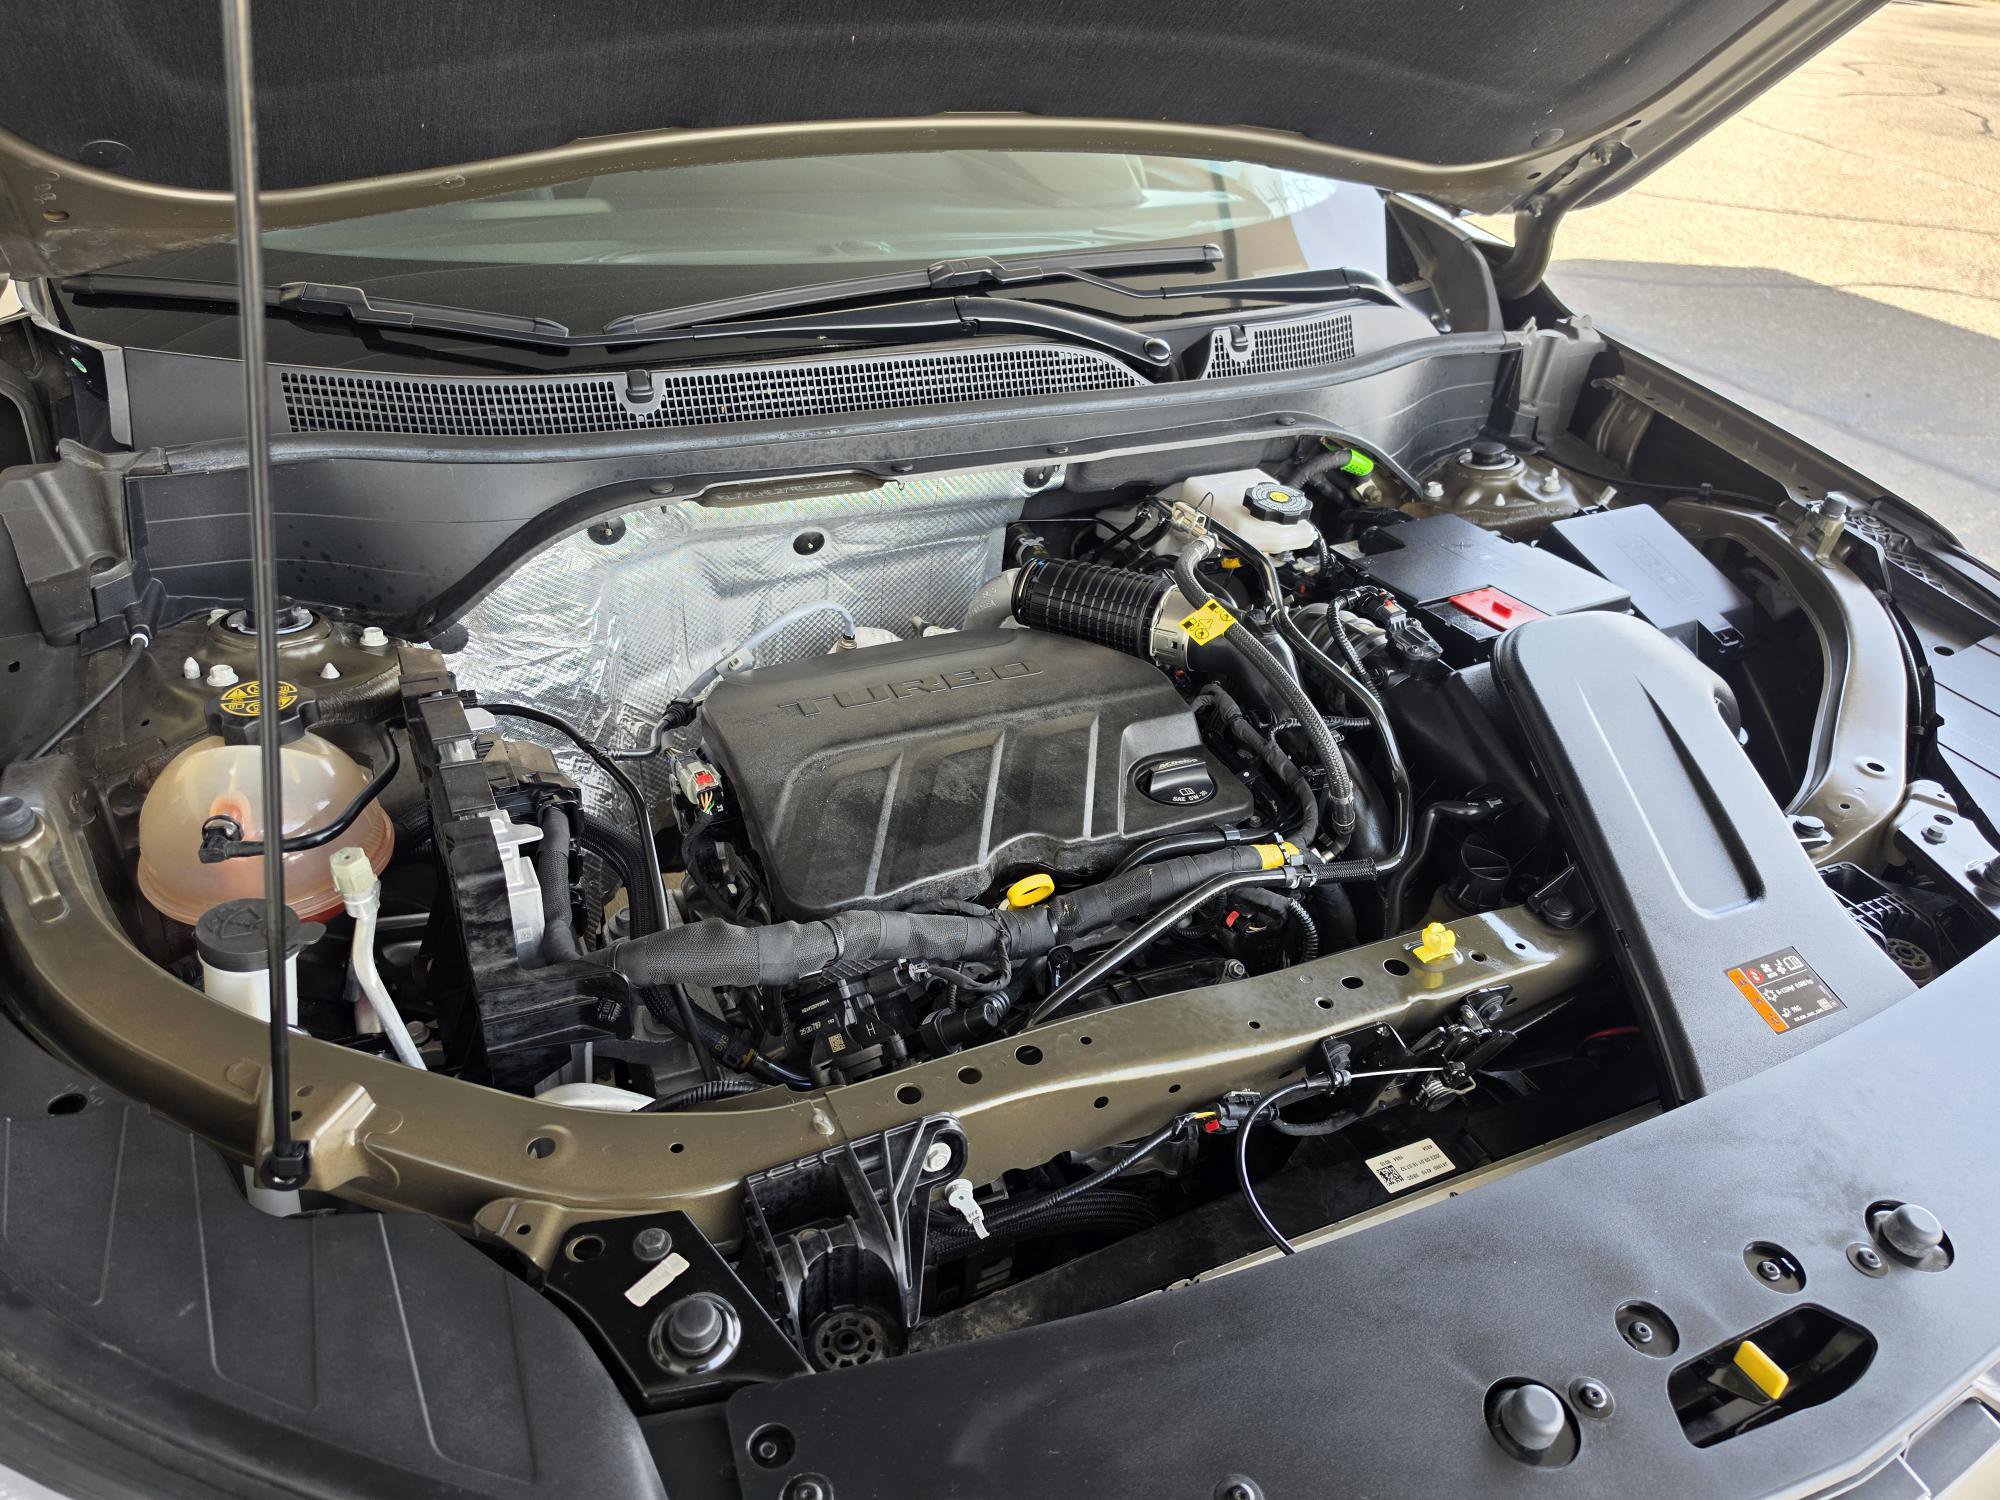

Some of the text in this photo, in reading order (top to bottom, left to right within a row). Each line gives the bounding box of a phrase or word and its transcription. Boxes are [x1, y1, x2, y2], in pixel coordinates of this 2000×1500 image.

[777, 659, 1045, 718] TURBO
[1158, 758, 1198, 770] ACDelco
[865, 1021, 877, 1037] H
